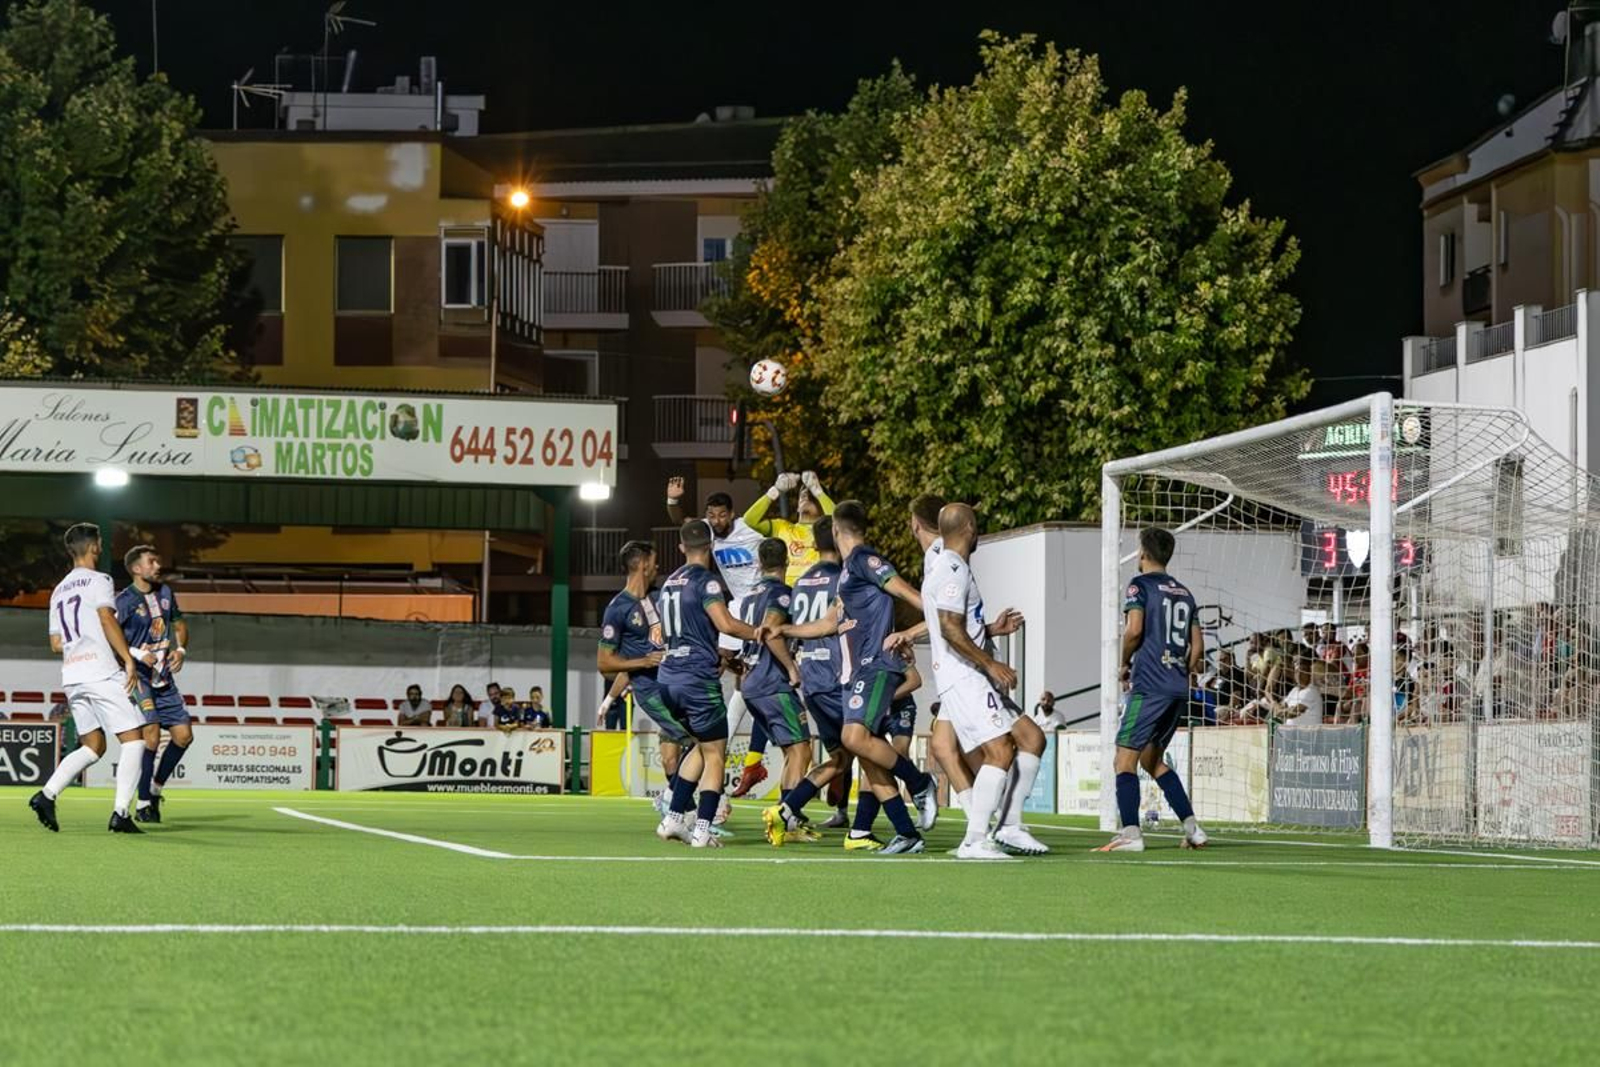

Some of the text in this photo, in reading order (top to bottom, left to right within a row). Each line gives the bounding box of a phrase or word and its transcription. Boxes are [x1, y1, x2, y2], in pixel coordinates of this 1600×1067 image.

[34, 392, 110, 422] Salones
[86, 422, 193, 465] Luisa
[450, 426, 613, 468] 644 52 62 04
[275, 442, 374, 477] MARTOS
[1322, 532, 1337, 568] 3
[57, 594, 82, 642] 17
[662, 591, 682, 637] 11
[1163, 598, 1190, 647] 19
[854, 680, 865, 694] 9
[987, 692, 998, 710] 4
[0, 729, 53, 746] ELOJES
[212, 744, 297, 757] 623 140 948
[206, 764, 302, 774] PUERTAS SECCIONALES
[427, 750, 524, 778] Monti
[223, 776, 291, 784] AUTOMATISMOS
[427, 783, 549, 794] www.mueblesmonti.es
